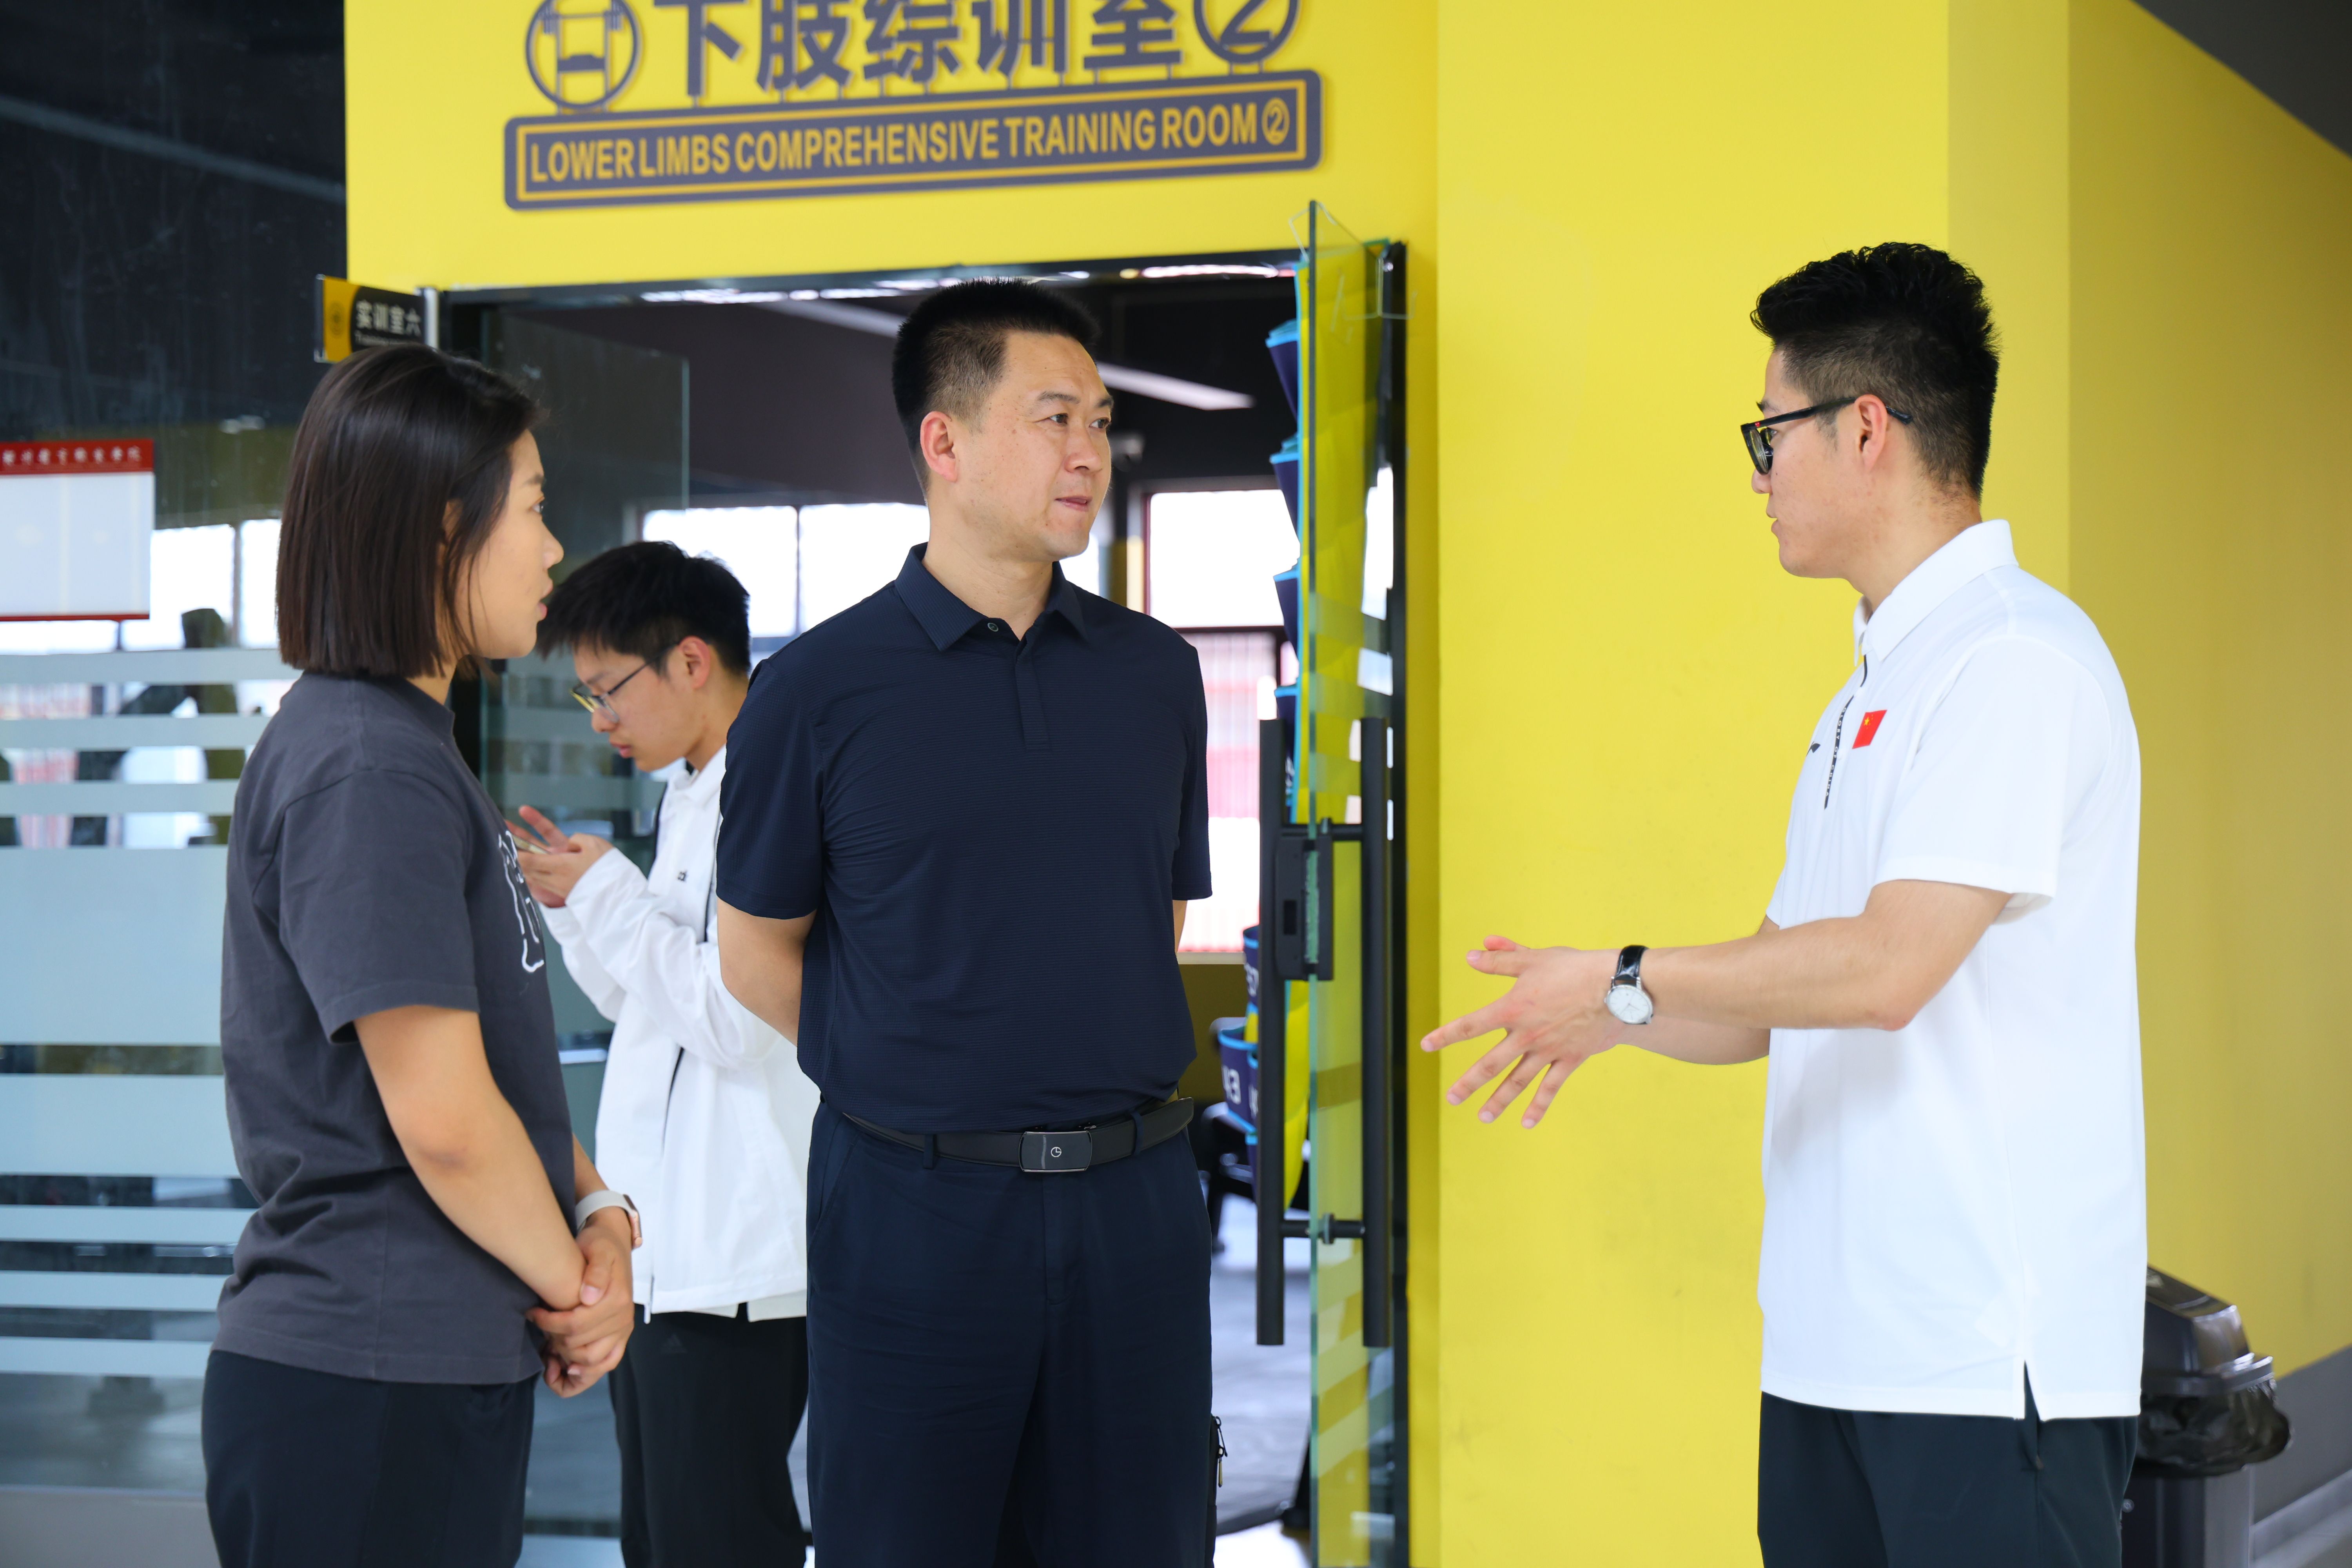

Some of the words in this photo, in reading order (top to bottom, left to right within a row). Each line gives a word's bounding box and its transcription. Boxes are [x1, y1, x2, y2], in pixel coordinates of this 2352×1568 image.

[530, 139, 635, 182] LOWER
[639, 132, 730, 178] LIMBS
[734, 118, 1000, 173] COMPREHENSIVE
[1004, 108, 1156, 158] TRAINING
[1161, 102, 1258, 149] ROOM
[1836, 707, 1847, 740] GLORY
[1833, 746, 1838, 758] OF
[1826, 764, 1834, 797] CHINA
